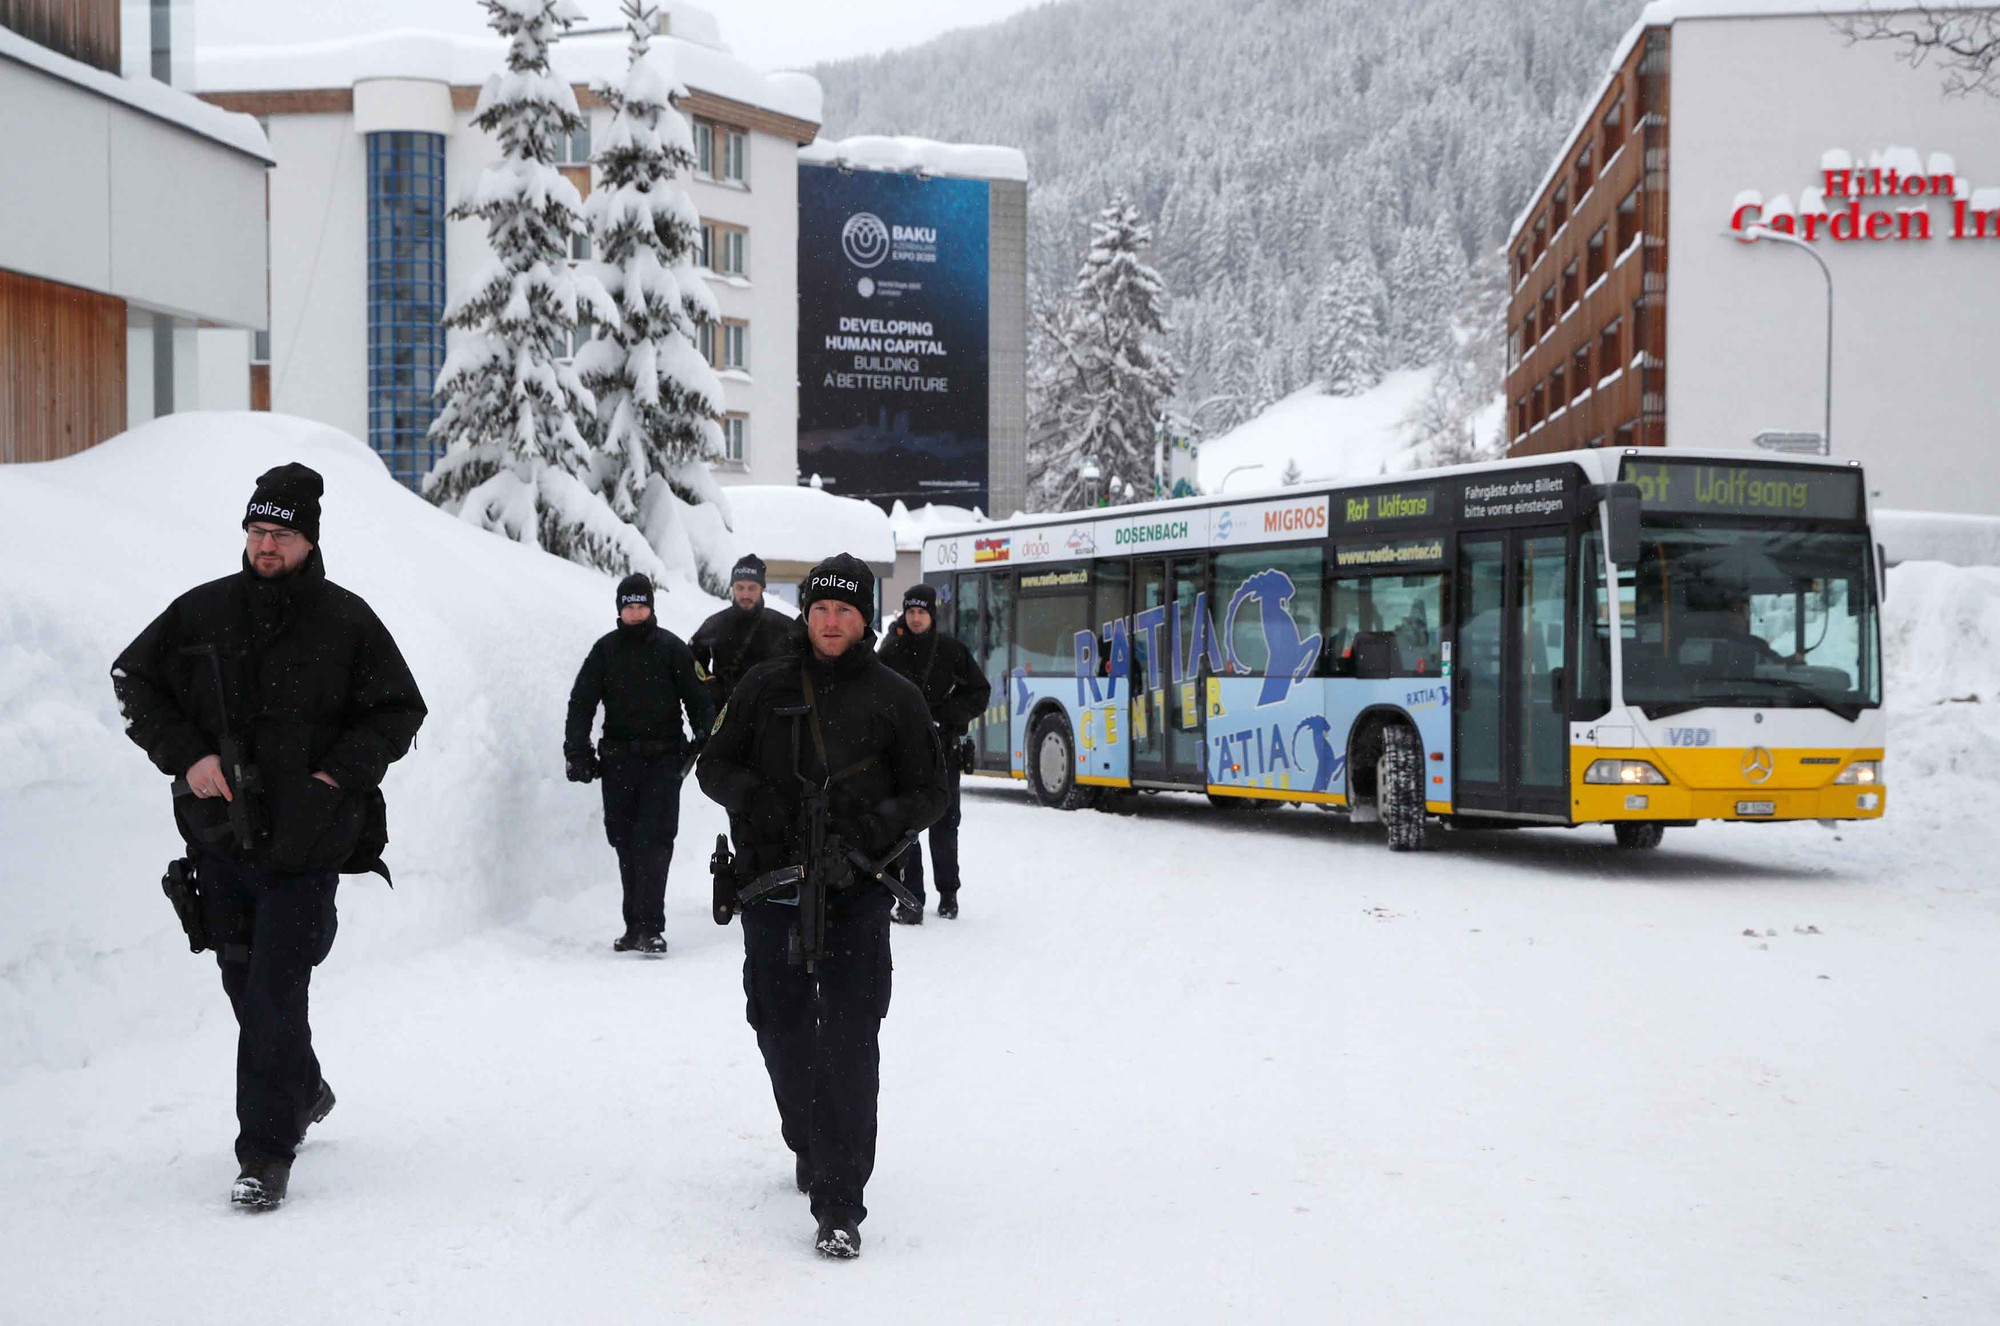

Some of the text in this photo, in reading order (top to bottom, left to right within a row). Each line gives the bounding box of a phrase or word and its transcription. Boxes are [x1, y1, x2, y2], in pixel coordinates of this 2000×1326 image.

[1821, 167, 1956, 199] Hilton
[1730, 201, 1933, 244] Garden
[892, 225, 937, 243] BAKU
[839, 316, 933, 336] DEVELOPING
[825, 335, 948, 356] HUMAN CAPITAL
[854, 355, 919, 373] BUILDING
[823, 372, 949, 393] A BETTER FUTURE
[1464, 478, 1564, 501] Fahrgäste ohne Billett
[1695, 467, 1809, 509] Wolfgang
[248, 501, 296, 521] Polizei
[1347, 493, 1427, 521] Rot Wolfgang
[1464, 497, 1563, 518] bitte vorne einsteigen
[1264, 506, 1326, 532] MIGROS
[1115, 521, 1189, 545] DOSENBACH
[937, 542, 958, 566] OVS
[734, 566, 758, 575] Polizei
[811, 574, 859, 593] Polizei
[621, 594, 647, 604] Polizei
[1668, 727, 1712, 747] VBD
